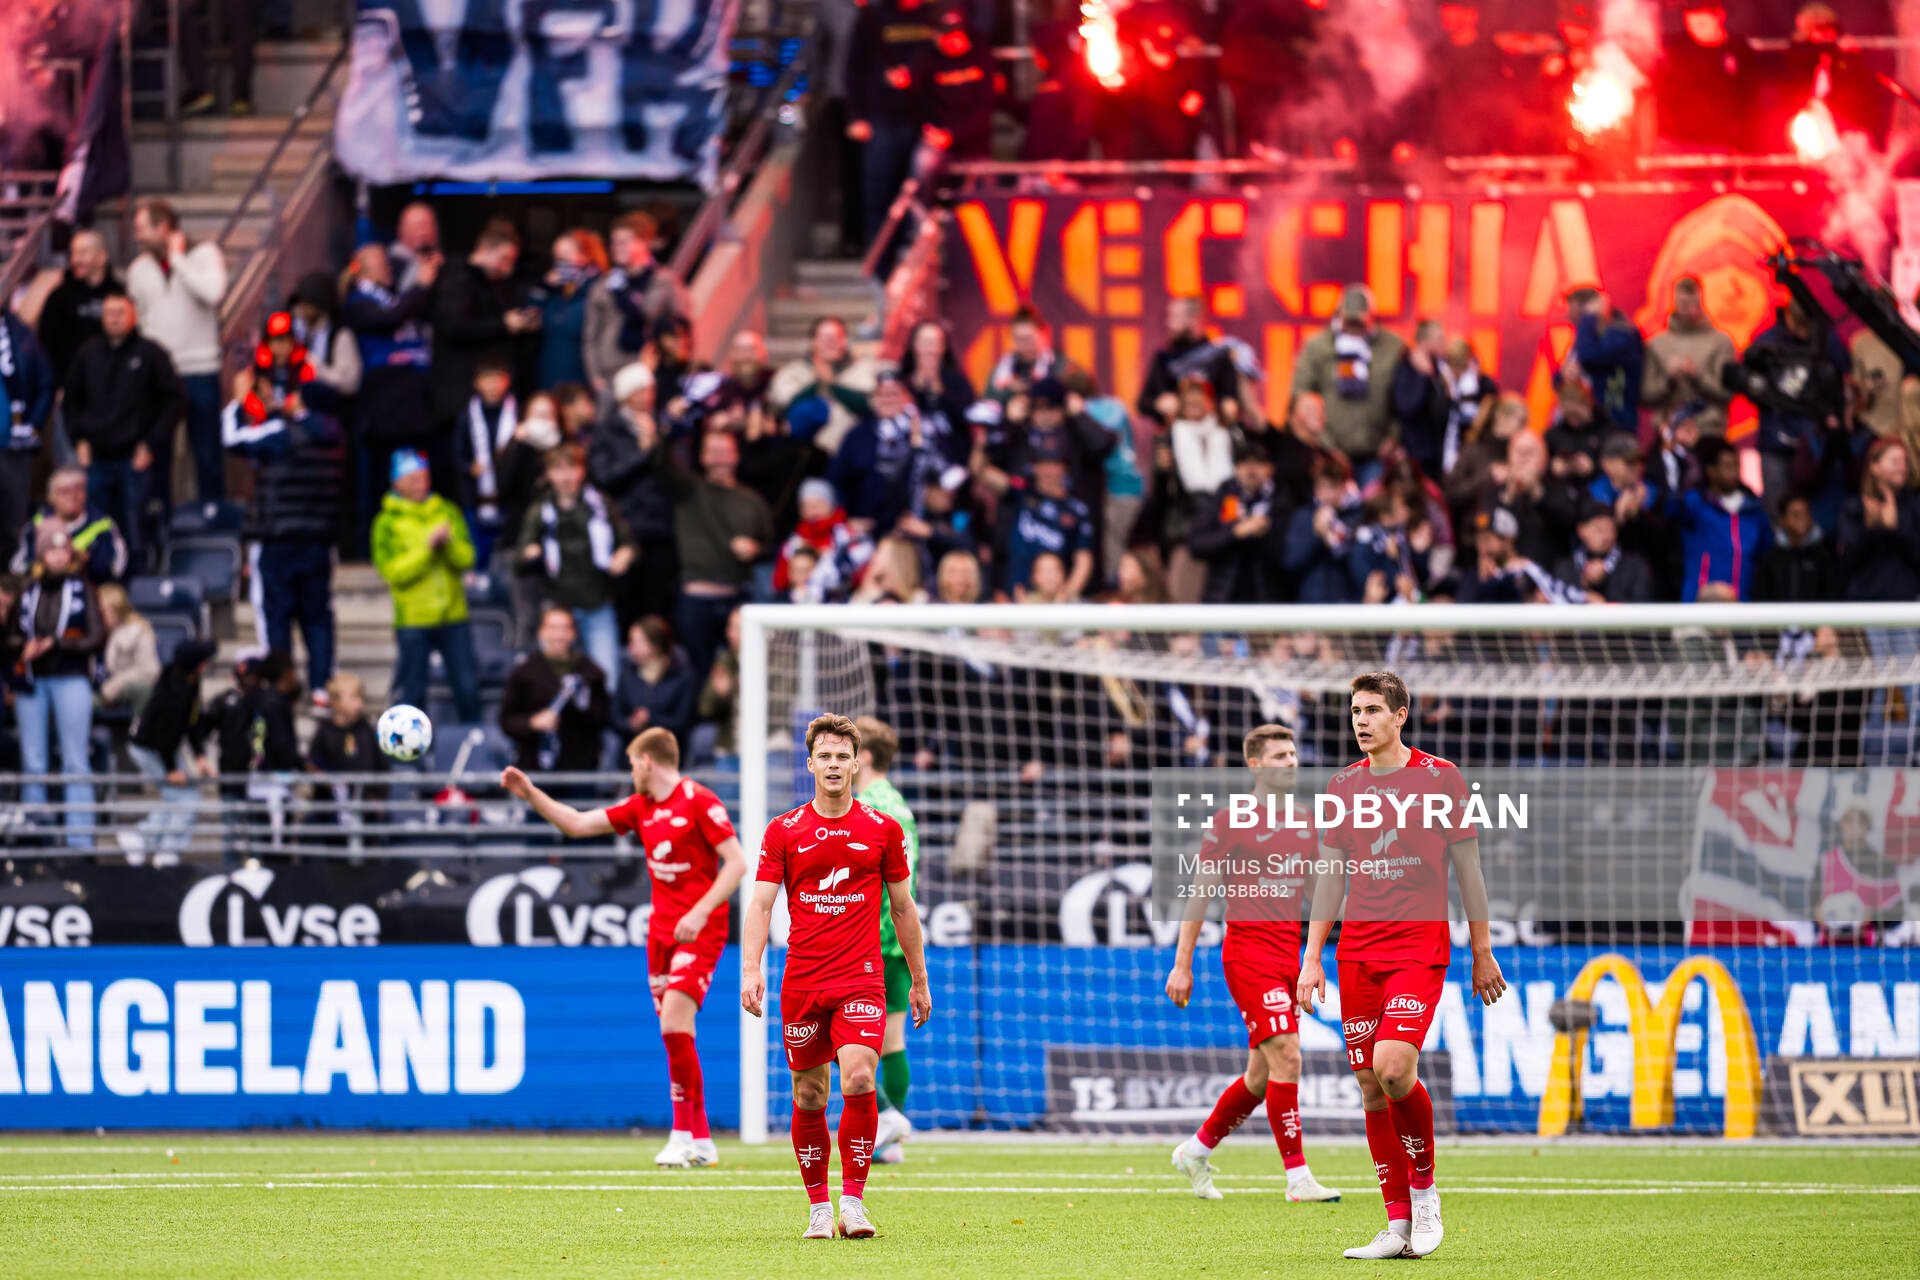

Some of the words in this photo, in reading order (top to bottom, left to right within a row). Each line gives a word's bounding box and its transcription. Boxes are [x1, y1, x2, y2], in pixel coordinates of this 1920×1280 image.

[957, 200, 1602, 316] VECCHIA
[799, 891, 865, 904] Sparebanken
[814, 903, 846, 915] Norge
[844, 1002, 883, 1017] LERØY
[785, 1023, 816, 1038] LERØY
[1348, 1048, 1365, 1065] 26
[1070, 1077, 1117, 1110] TS
